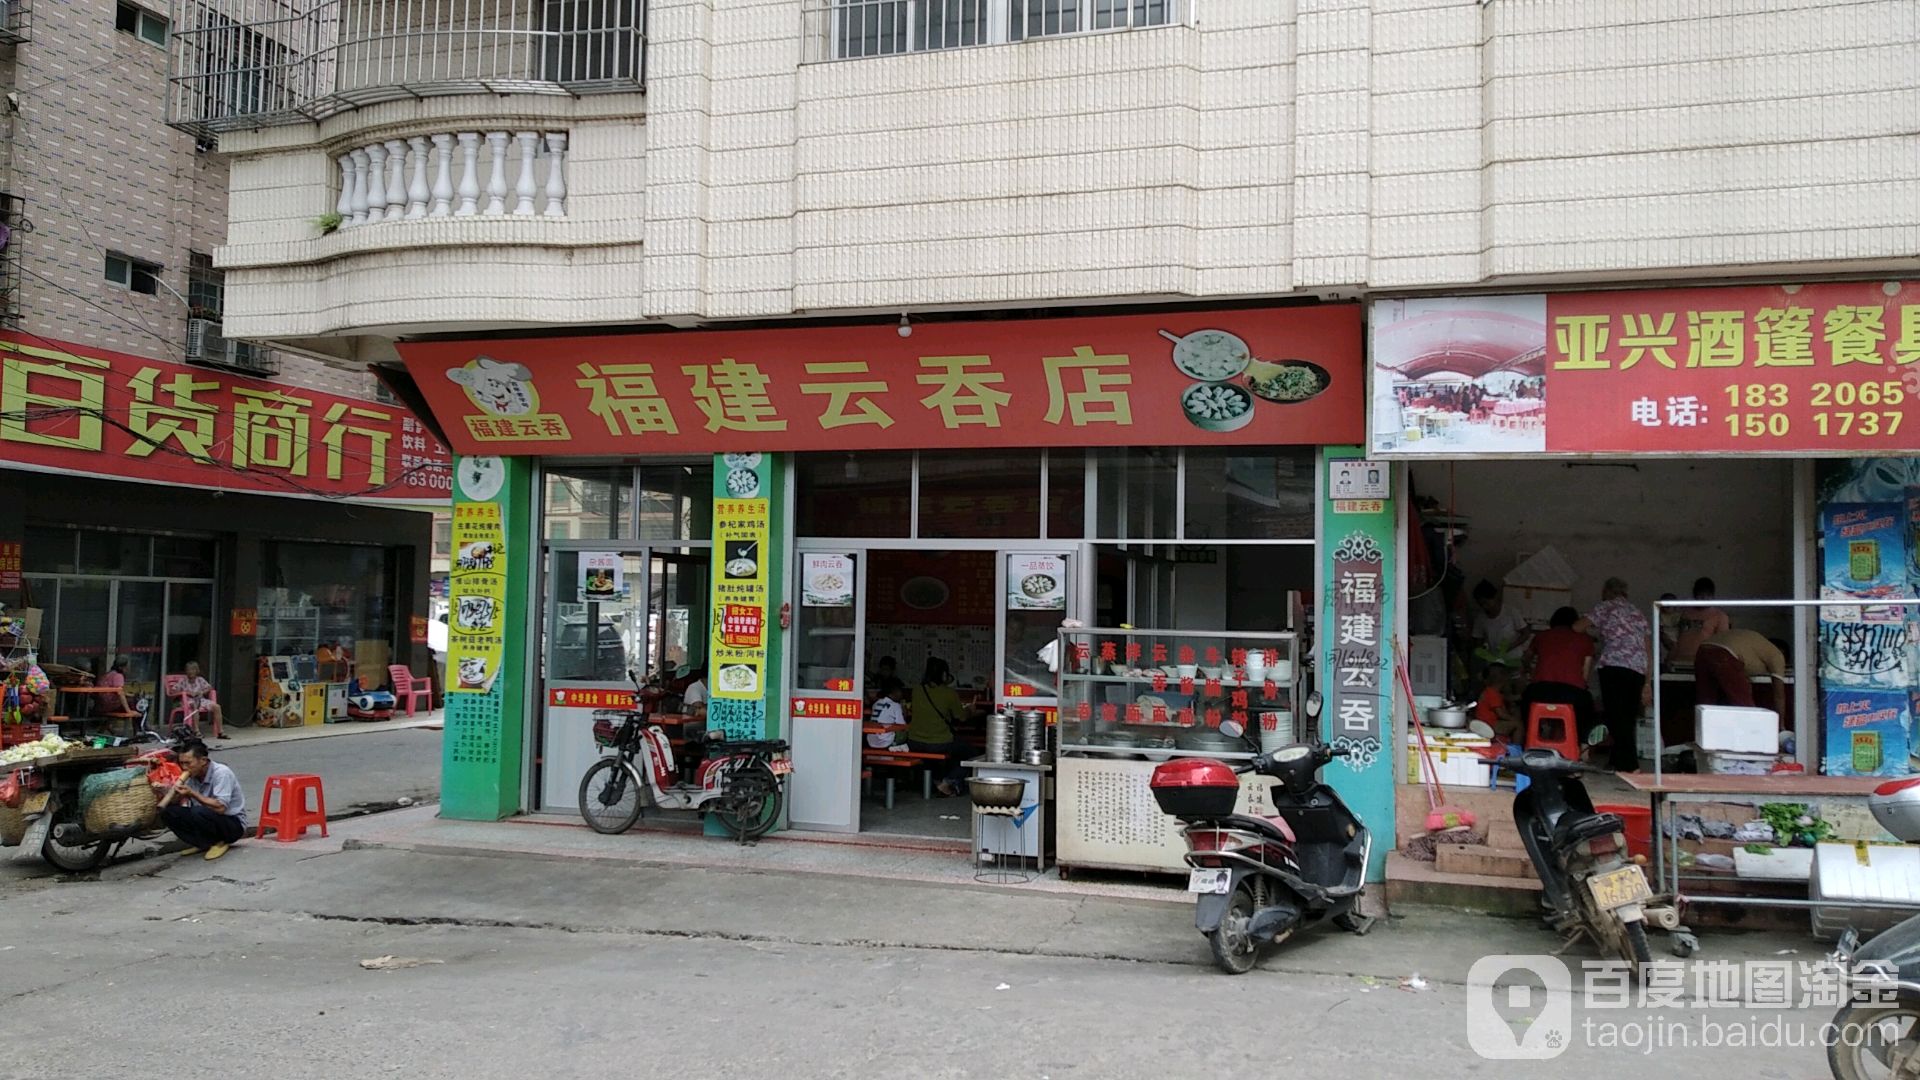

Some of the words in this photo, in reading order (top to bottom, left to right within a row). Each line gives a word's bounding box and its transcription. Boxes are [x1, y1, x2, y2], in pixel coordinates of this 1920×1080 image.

[576, 346, 1133, 436] 福建云吞店
[1725, 384, 1790, 408] 183
[1810, 381, 1904, 407] 2065
[0, 344, 391, 486] 百货商行
[1631, 396, 1709, 427] 电话:
[1724, 413, 1790, 437] 150
[1813, 411, 1904, 437] 1737
[470, 418, 563, 438] 福建云吞
[402, 434, 426, 453] 饮料
[456, 506, 501, 518] 营养养生
[717, 503, 766, 515] 营养养生汤
[1336, 501, 1381, 512] 福建云吞
[1339, 571, 1378, 731] 福建云吞
